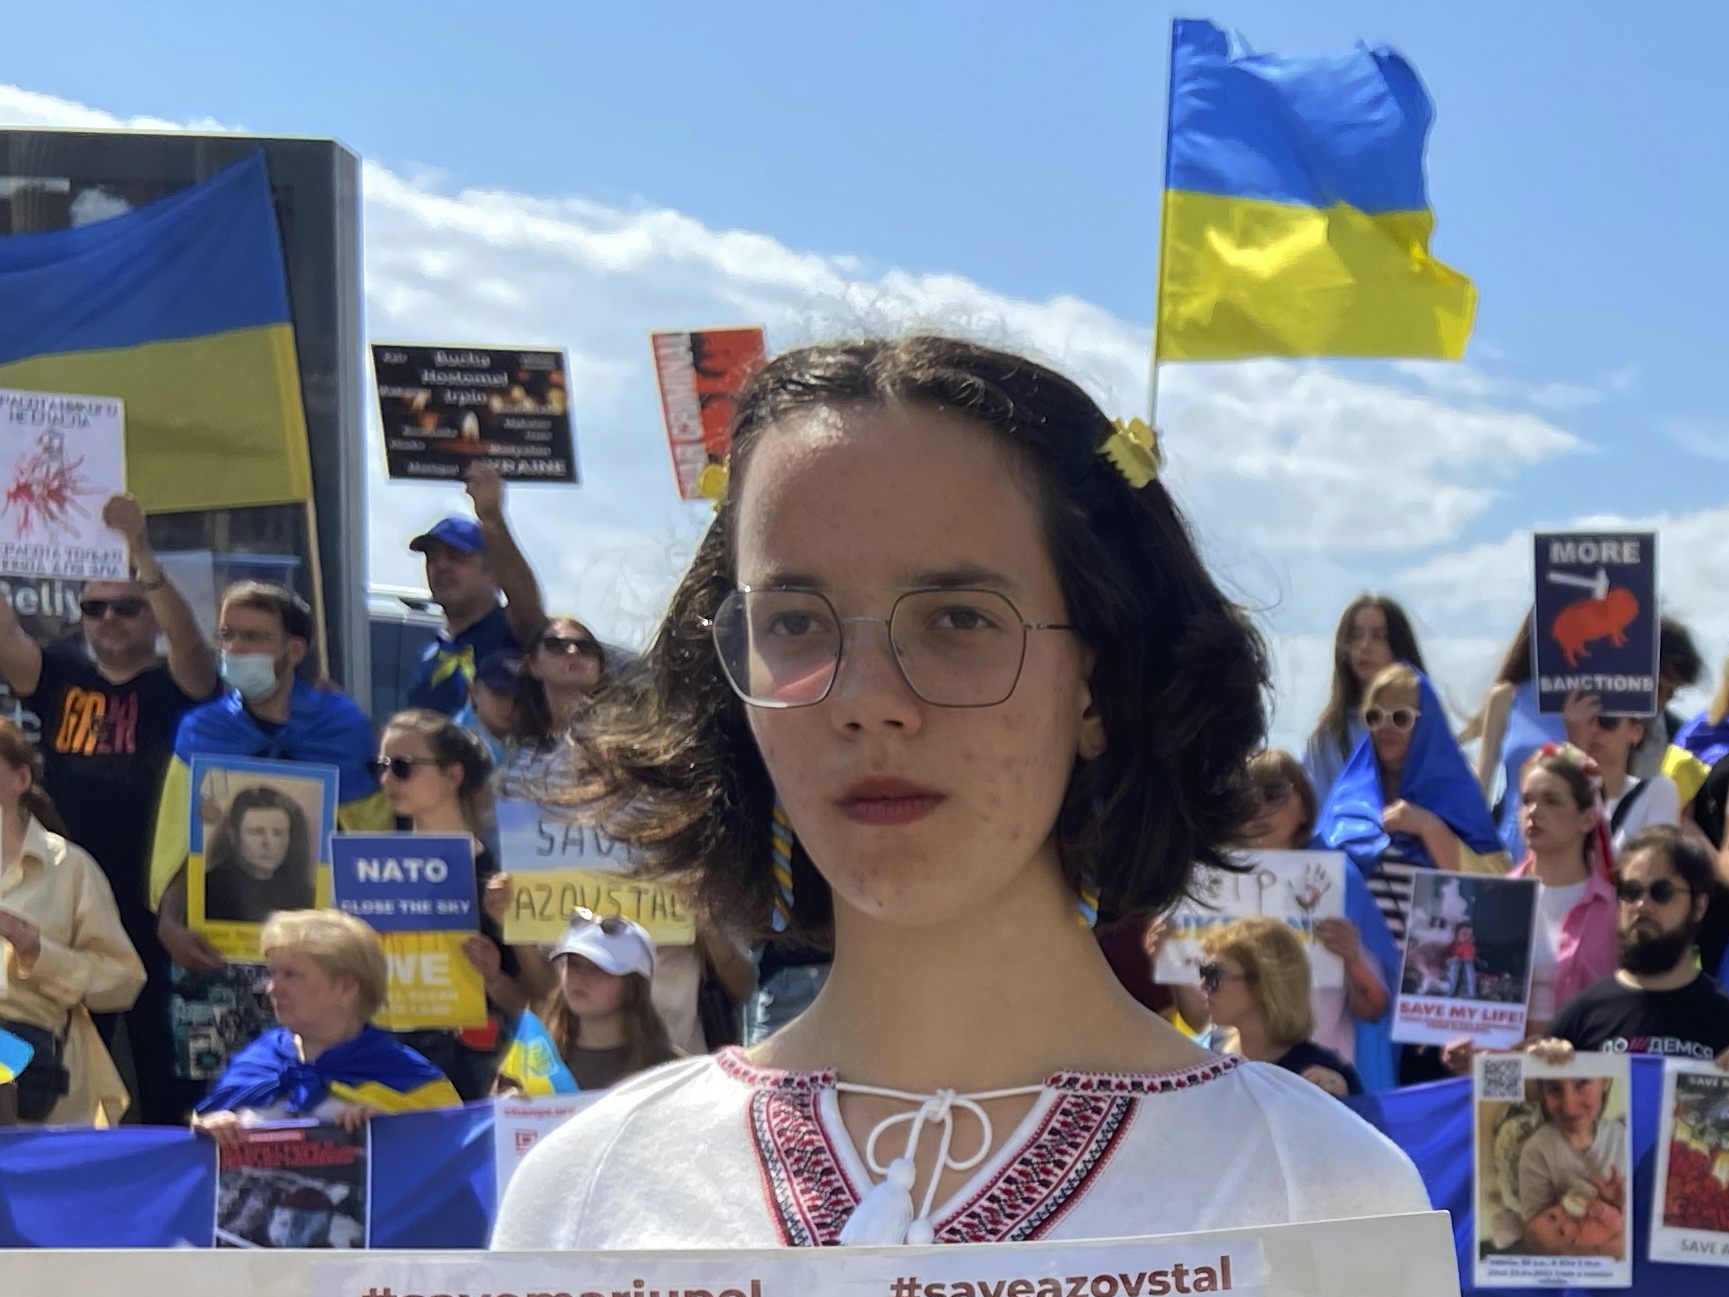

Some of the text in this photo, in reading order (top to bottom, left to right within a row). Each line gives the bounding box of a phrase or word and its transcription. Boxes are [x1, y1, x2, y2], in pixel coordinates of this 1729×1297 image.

[1551, 540, 1641, 565] MORE
[1540, 673, 1653, 692] SANCTIONS
[535, 819, 632, 861] SAV
[356, 857, 449, 883] NATO
[399, 900, 432, 915] THE
[515, 882, 687, 922] AZOVSTAL
[1400, 1001, 1445, 1017] SAVE
[1449, 1005, 1477, 1019] MY
[1680, 1238, 1717, 1254] SAVE
